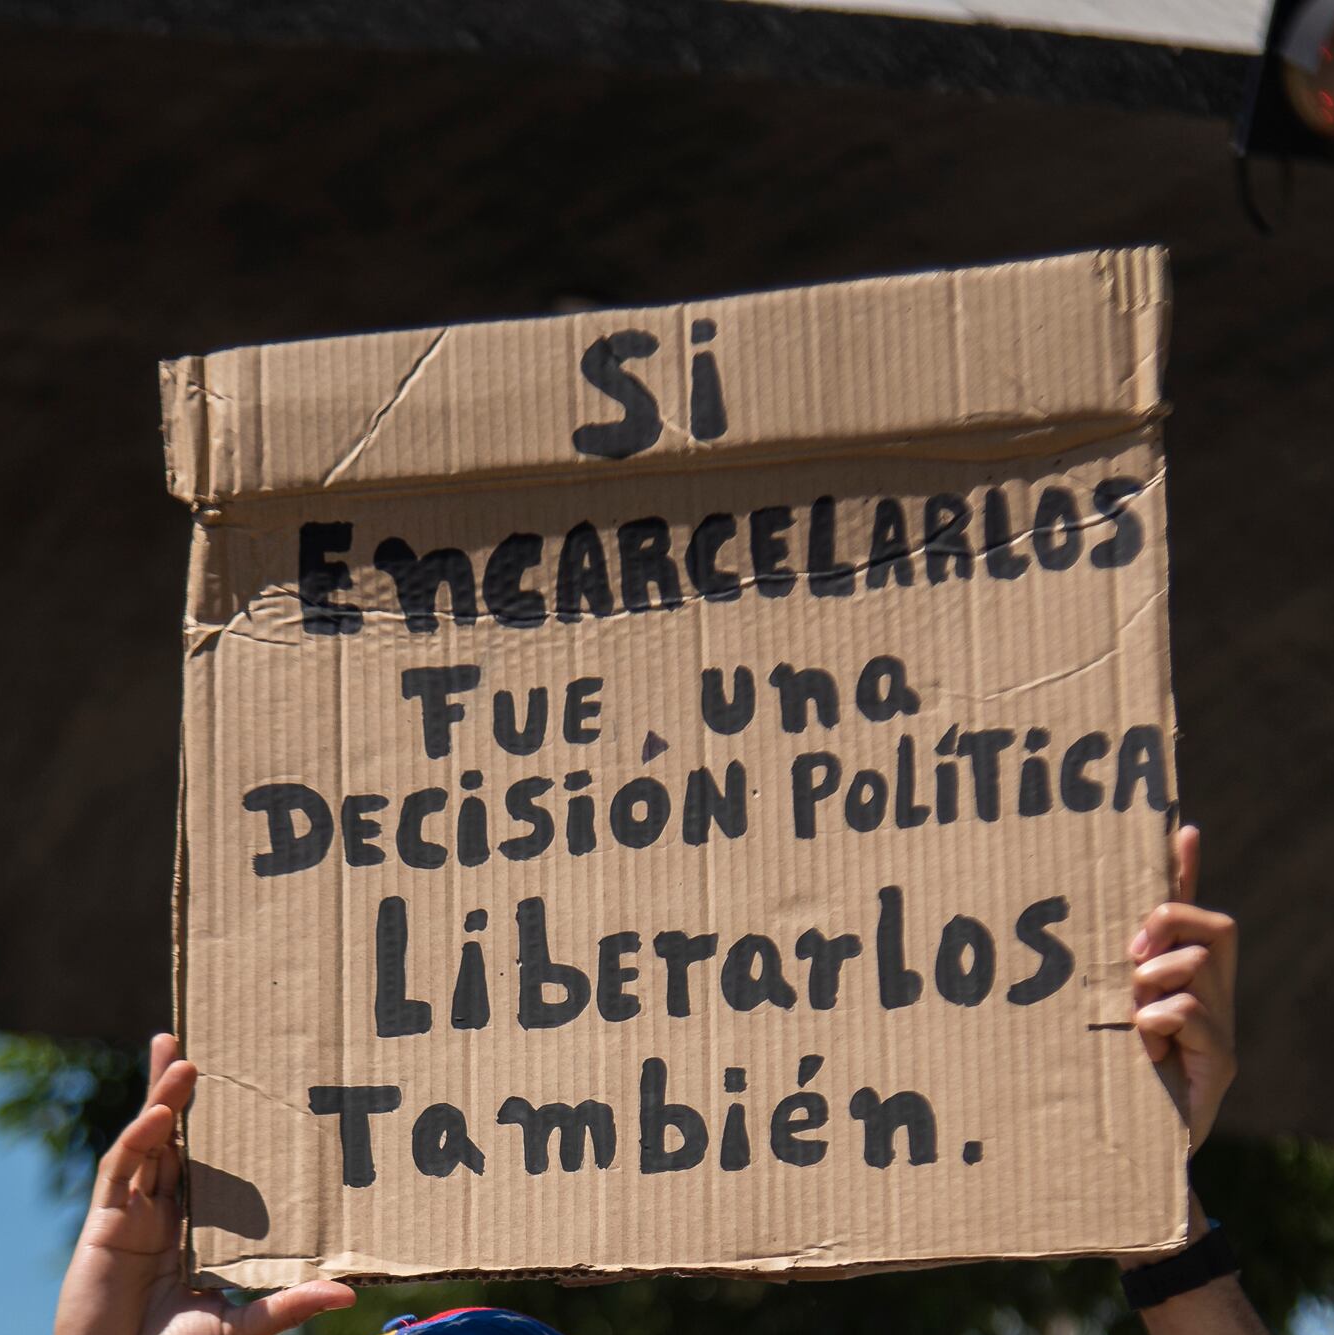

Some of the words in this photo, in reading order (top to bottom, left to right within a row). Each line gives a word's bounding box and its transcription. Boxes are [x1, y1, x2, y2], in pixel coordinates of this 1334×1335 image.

[401, 664, 605, 760] FUE
[701, 655, 921, 737] una
[307, 1053, 985, 1190] También.
